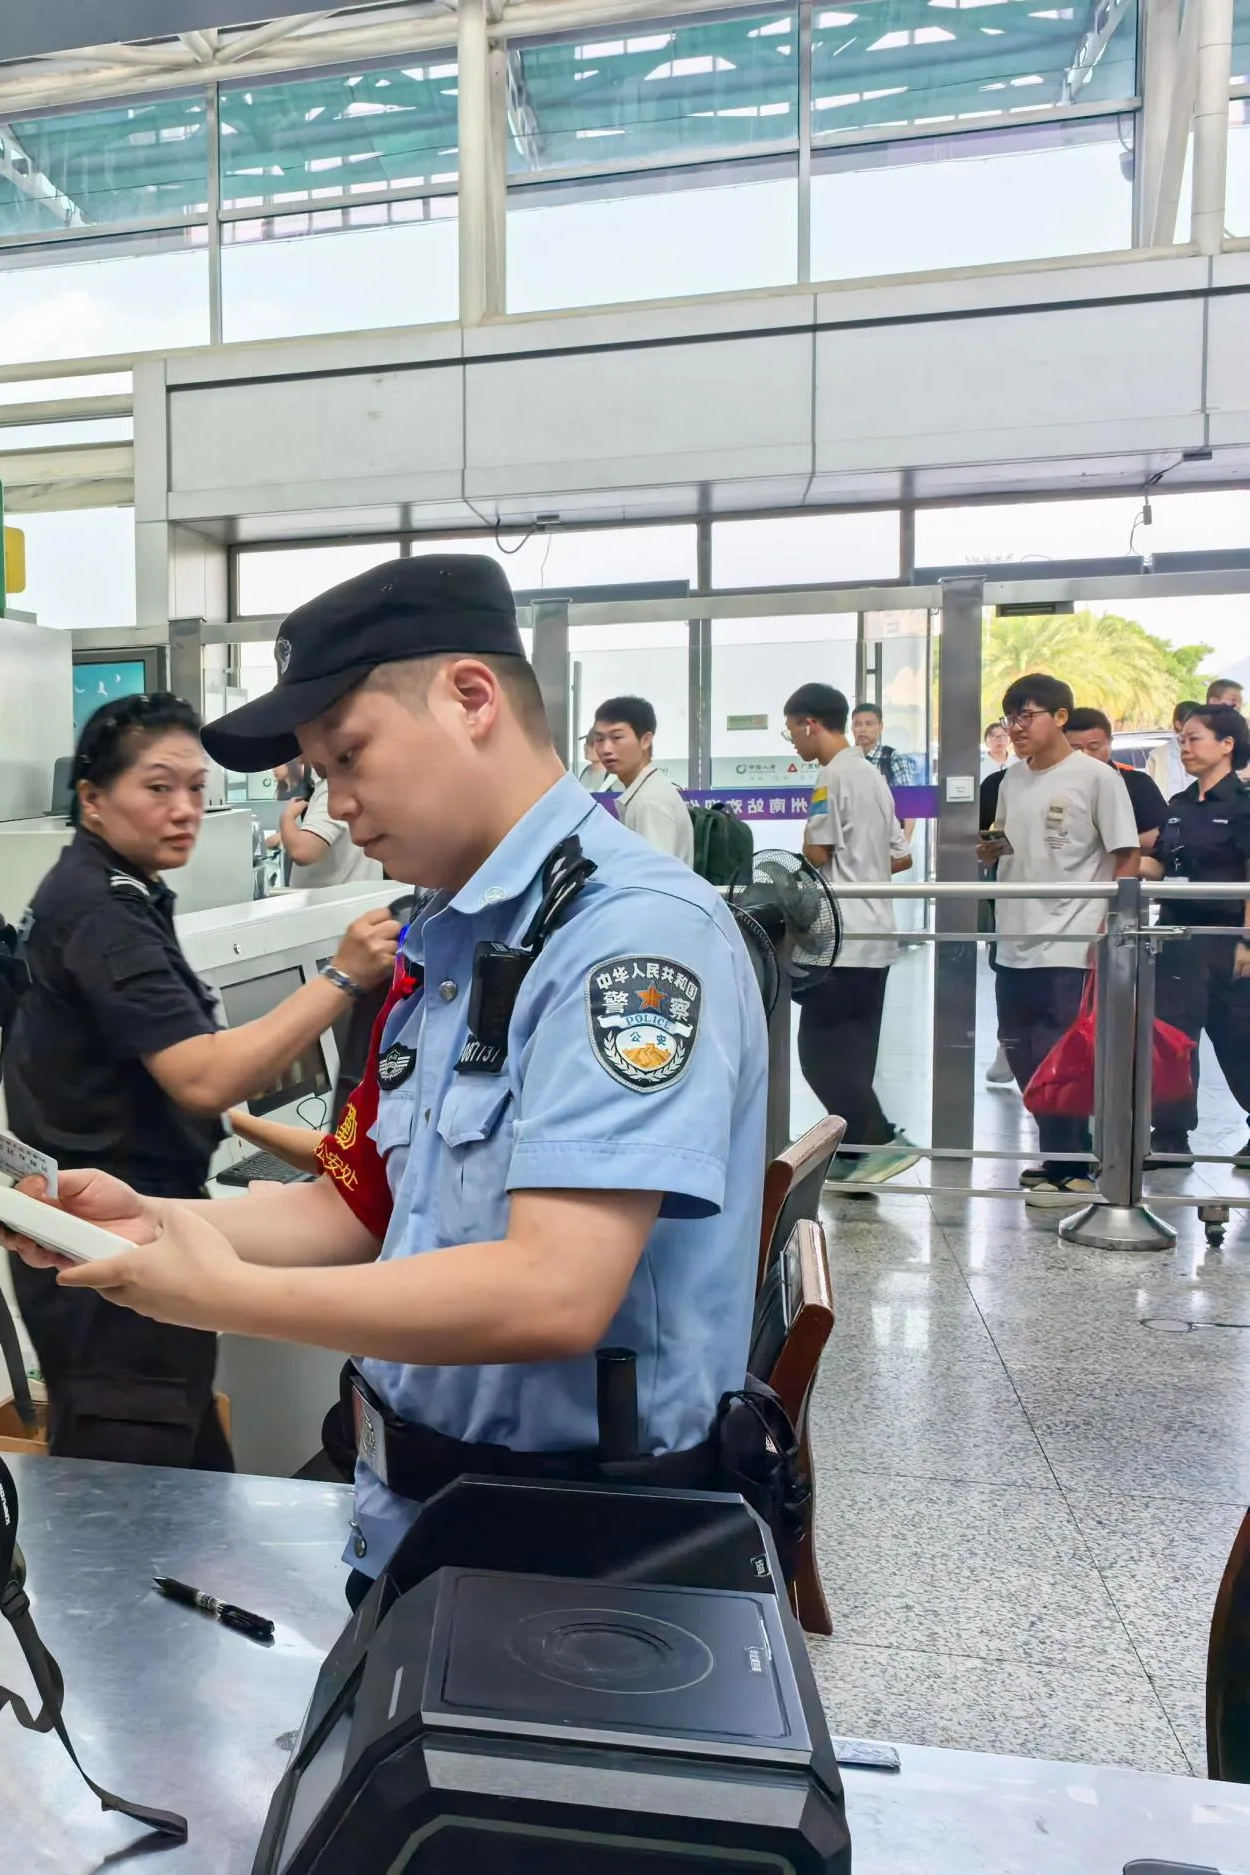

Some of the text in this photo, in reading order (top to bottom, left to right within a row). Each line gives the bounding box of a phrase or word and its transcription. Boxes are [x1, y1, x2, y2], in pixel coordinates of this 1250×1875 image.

[596, 963, 698, 1001] 中华人民共和国
[625, 1013, 672, 1029] POLICE
